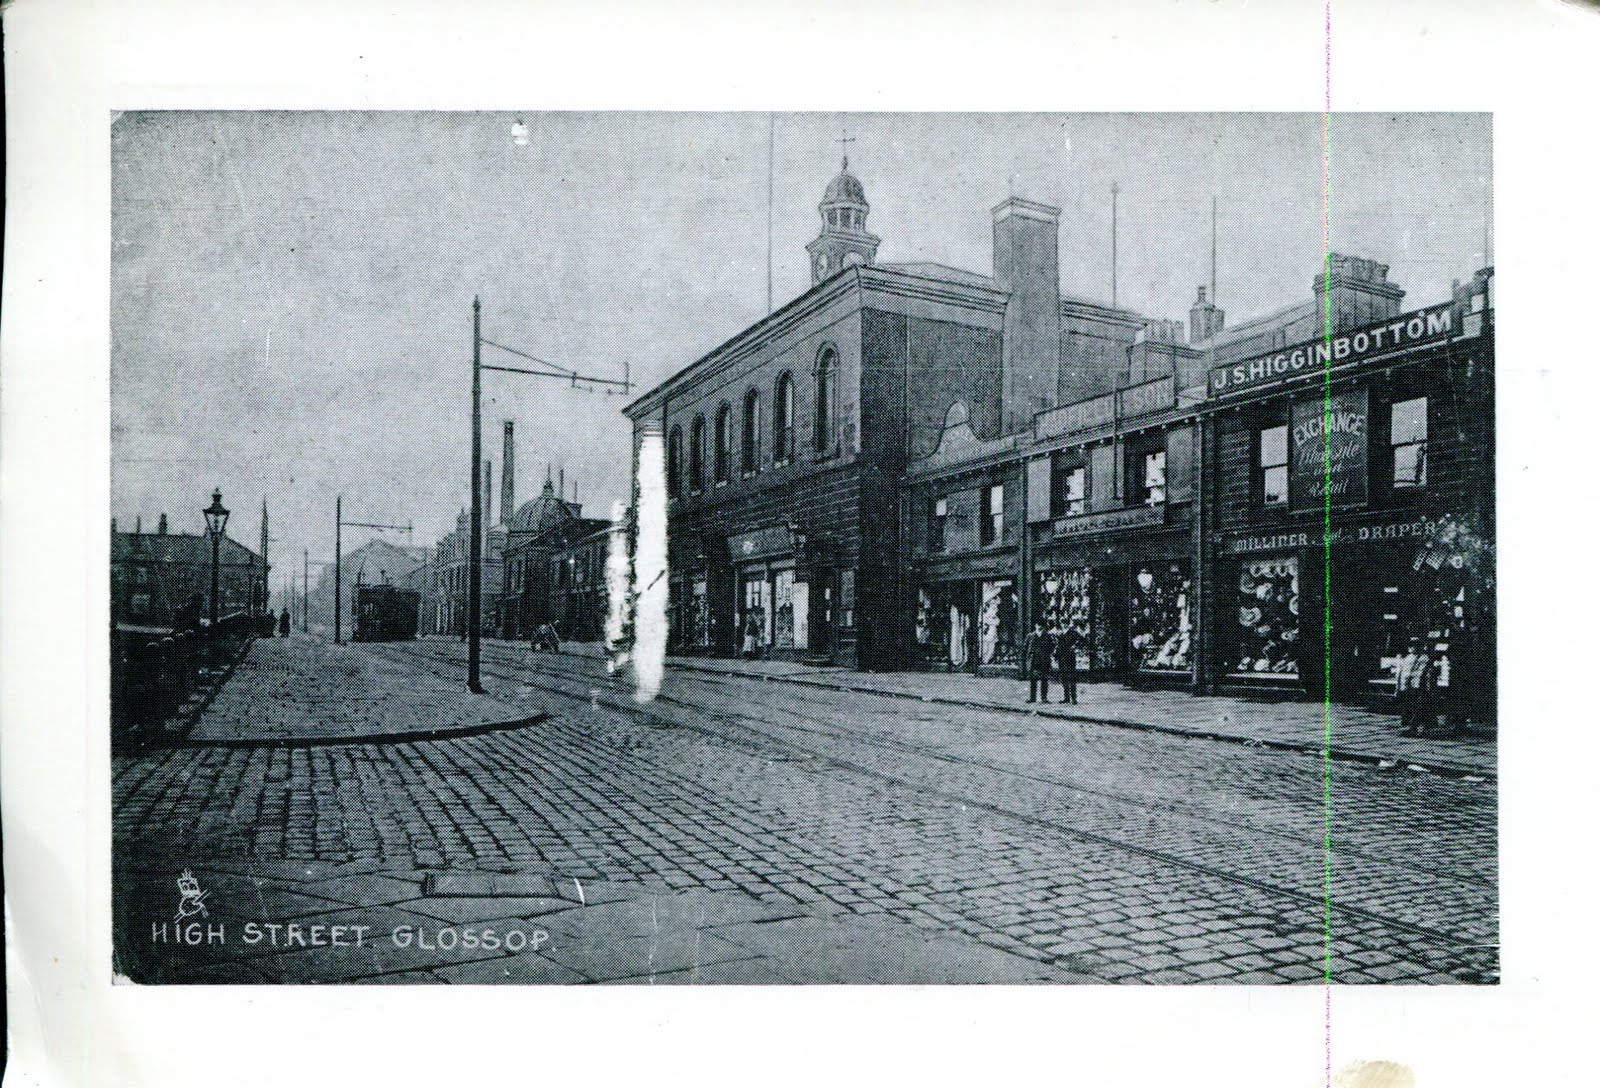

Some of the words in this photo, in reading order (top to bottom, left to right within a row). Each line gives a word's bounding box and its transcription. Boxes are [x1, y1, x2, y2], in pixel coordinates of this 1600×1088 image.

[1293, 412, 1367, 447] EXCHANGE
[1236, 532, 1308, 552] MILLINER
[1358, 521, 1436, 540] DRAPER
